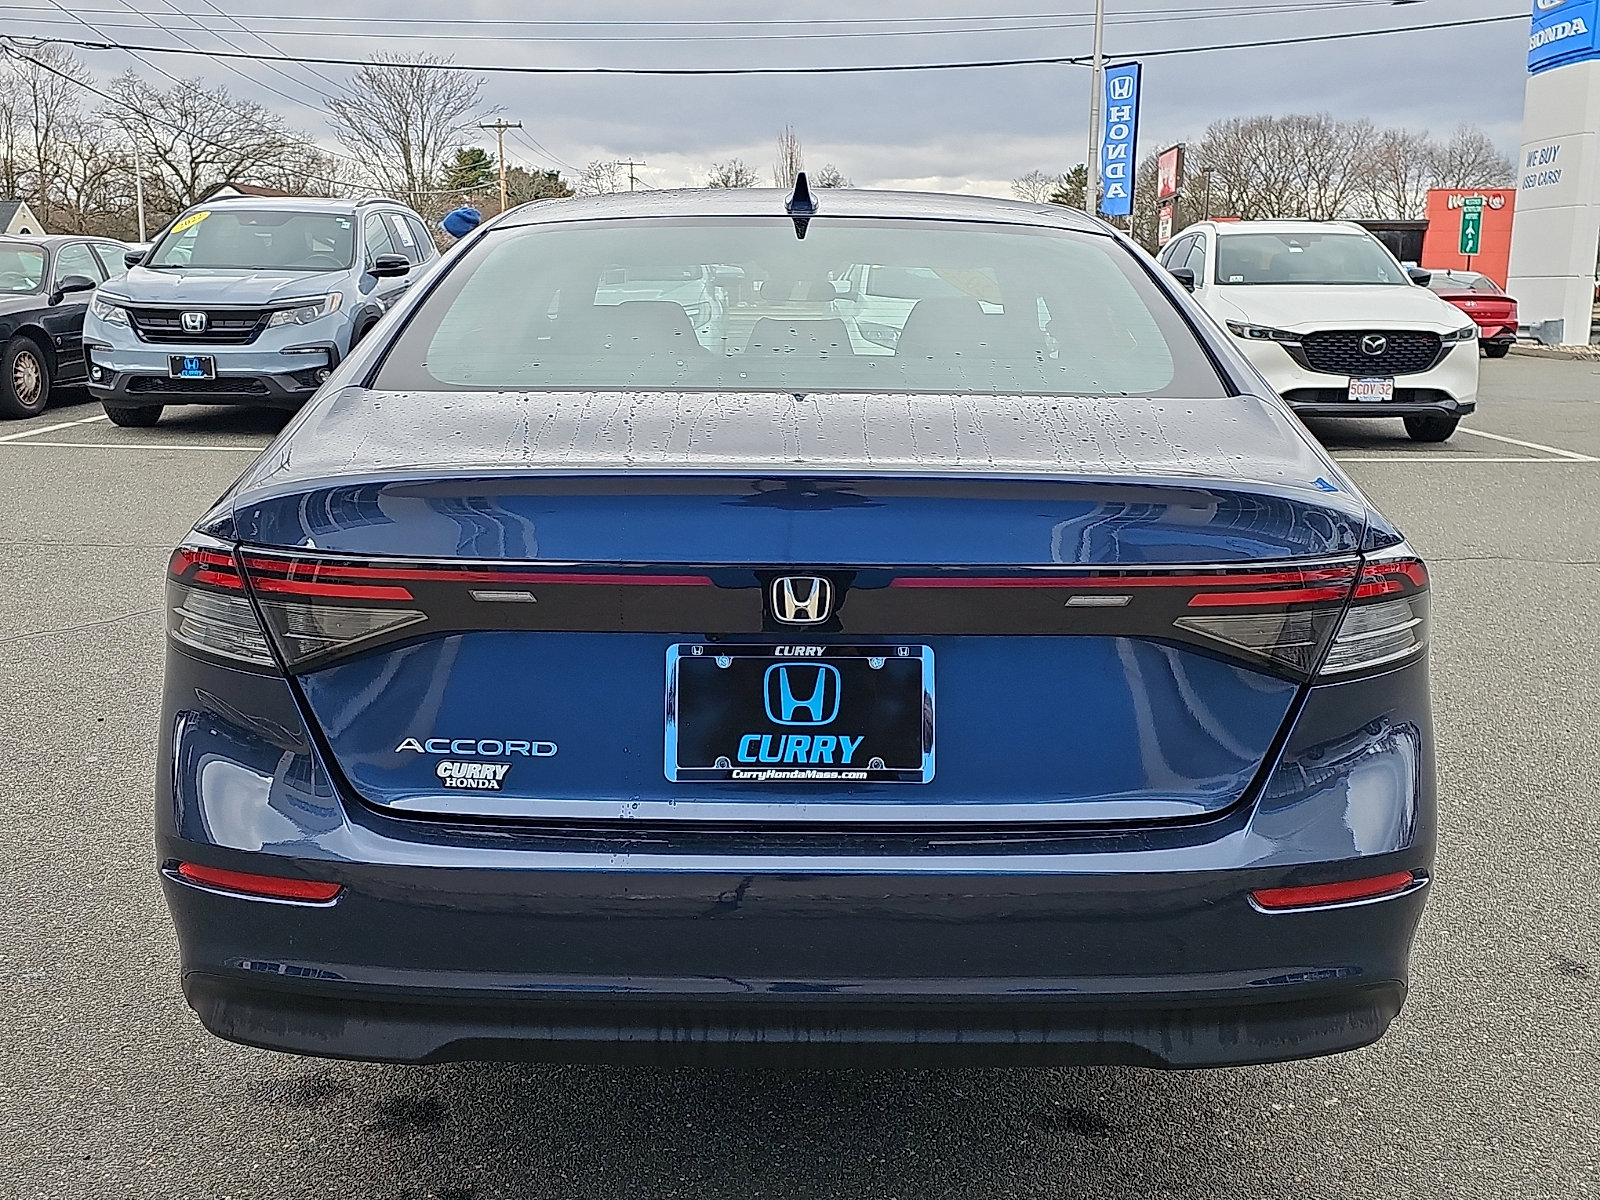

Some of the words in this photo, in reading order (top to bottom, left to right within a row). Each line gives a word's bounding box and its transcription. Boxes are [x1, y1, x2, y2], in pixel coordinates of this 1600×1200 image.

[1529, 17, 1588, 50] HONDA
[1526, 150, 1539, 168] WE
[1539, 144, 1560, 165] BUY
[1379, 384, 1392, 395] 32
[774, 645, 826, 656] CURRY
[394, 737, 558, 757] ACCORD
[737, 734, 865, 764] CURRY
[436, 761, 510, 780] CURRY
[731, 769, 868, 780] CurryHondaMass.com
[444, 777, 500, 789] HONDA
